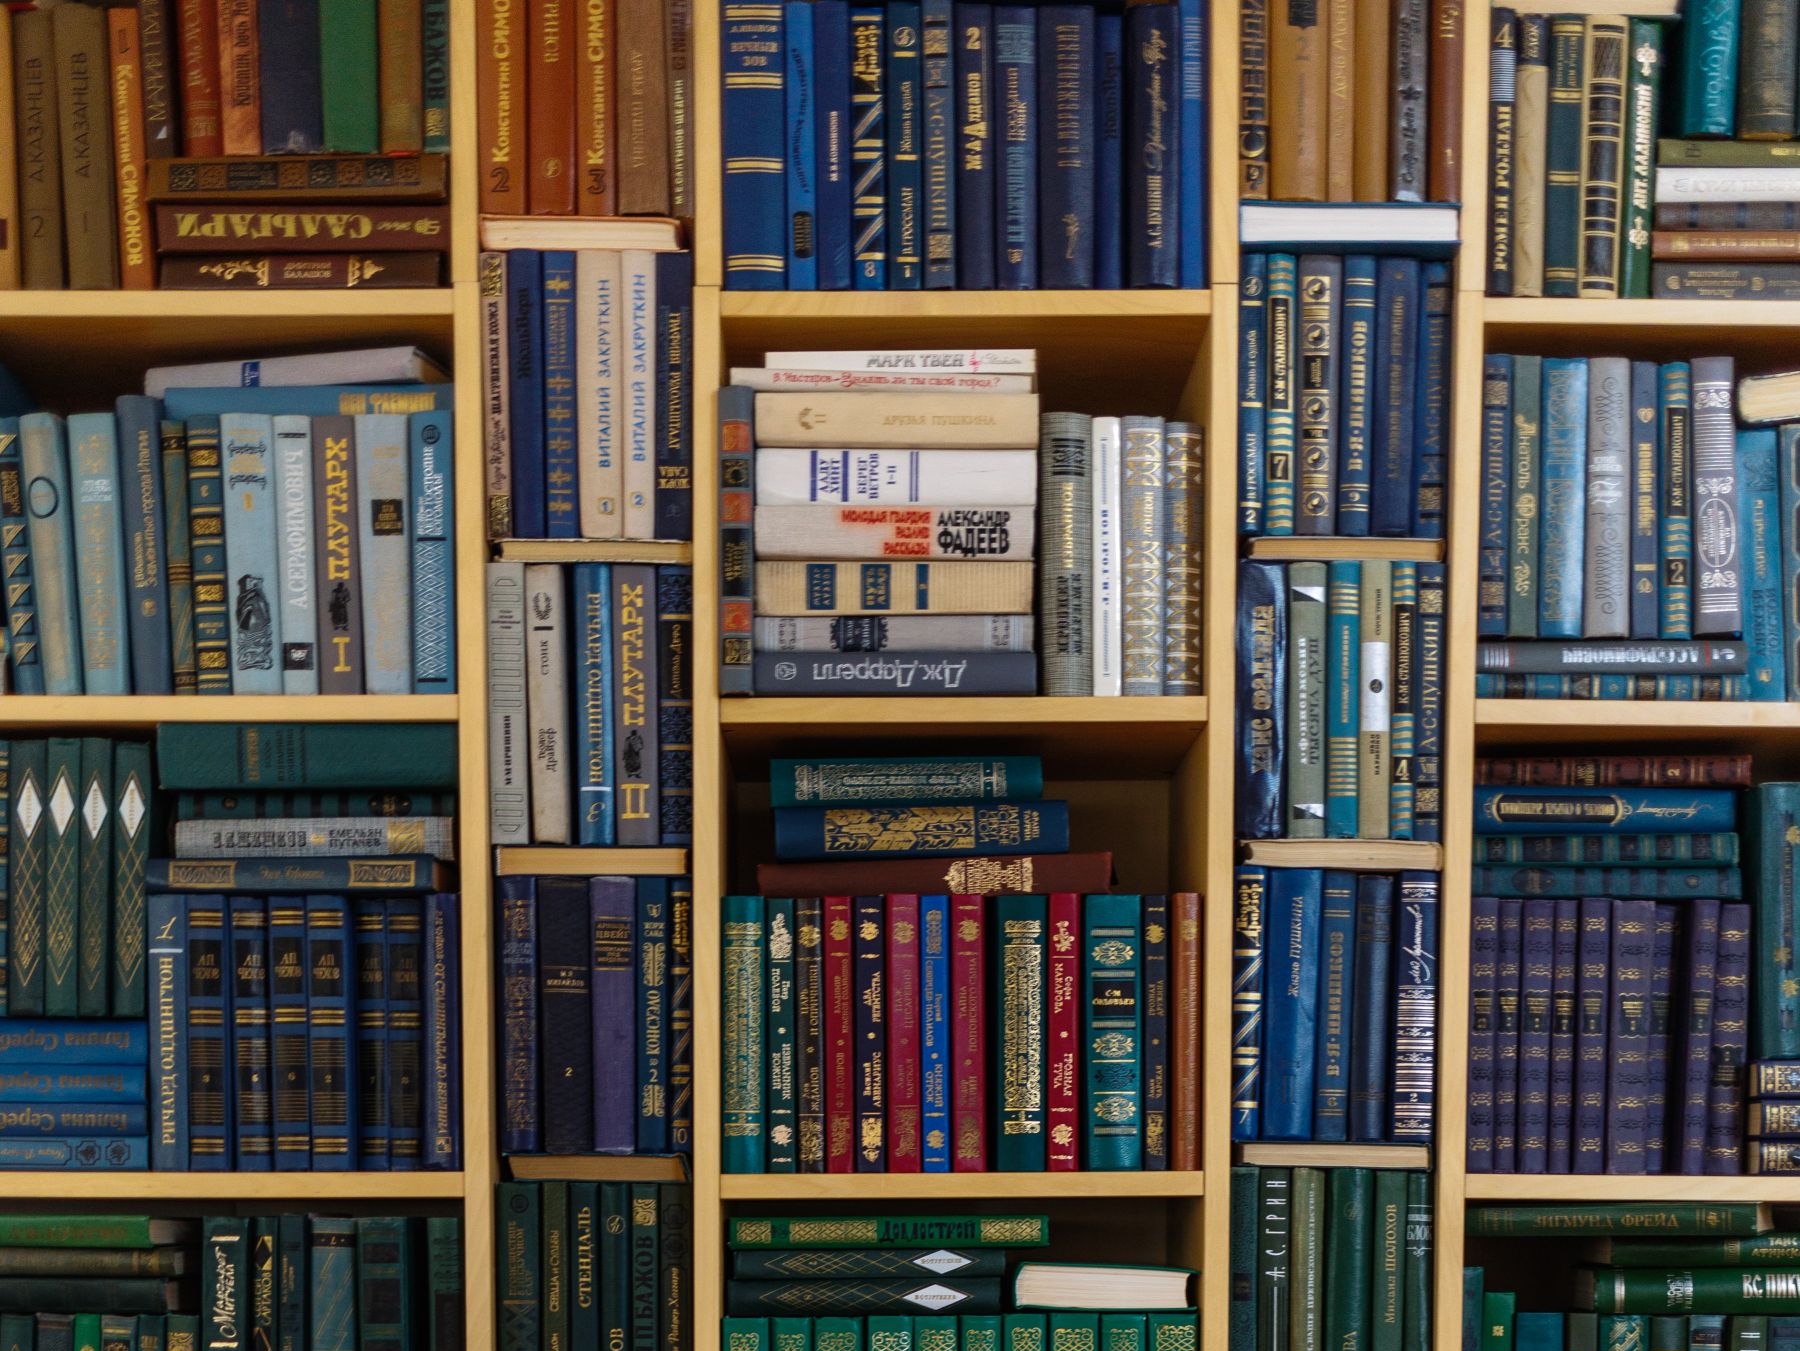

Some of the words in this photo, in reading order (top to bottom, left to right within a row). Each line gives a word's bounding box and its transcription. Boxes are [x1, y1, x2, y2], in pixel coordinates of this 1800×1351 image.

[598, 280, 610, 378] ЗАКРУТКИН
[632, 274, 646, 372] ЗАКРУТКИН
[599, 388, 611, 468] ВИТАЛИЙ
[632, 381, 646, 461] ВИТАЛИЙ
[326, 437, 349, 580] ПЛУТАРХ
[937, 528, 1010, 556] ФАДЕЕВ
[622, 584, 644, 726] ПЛУТАРХ
